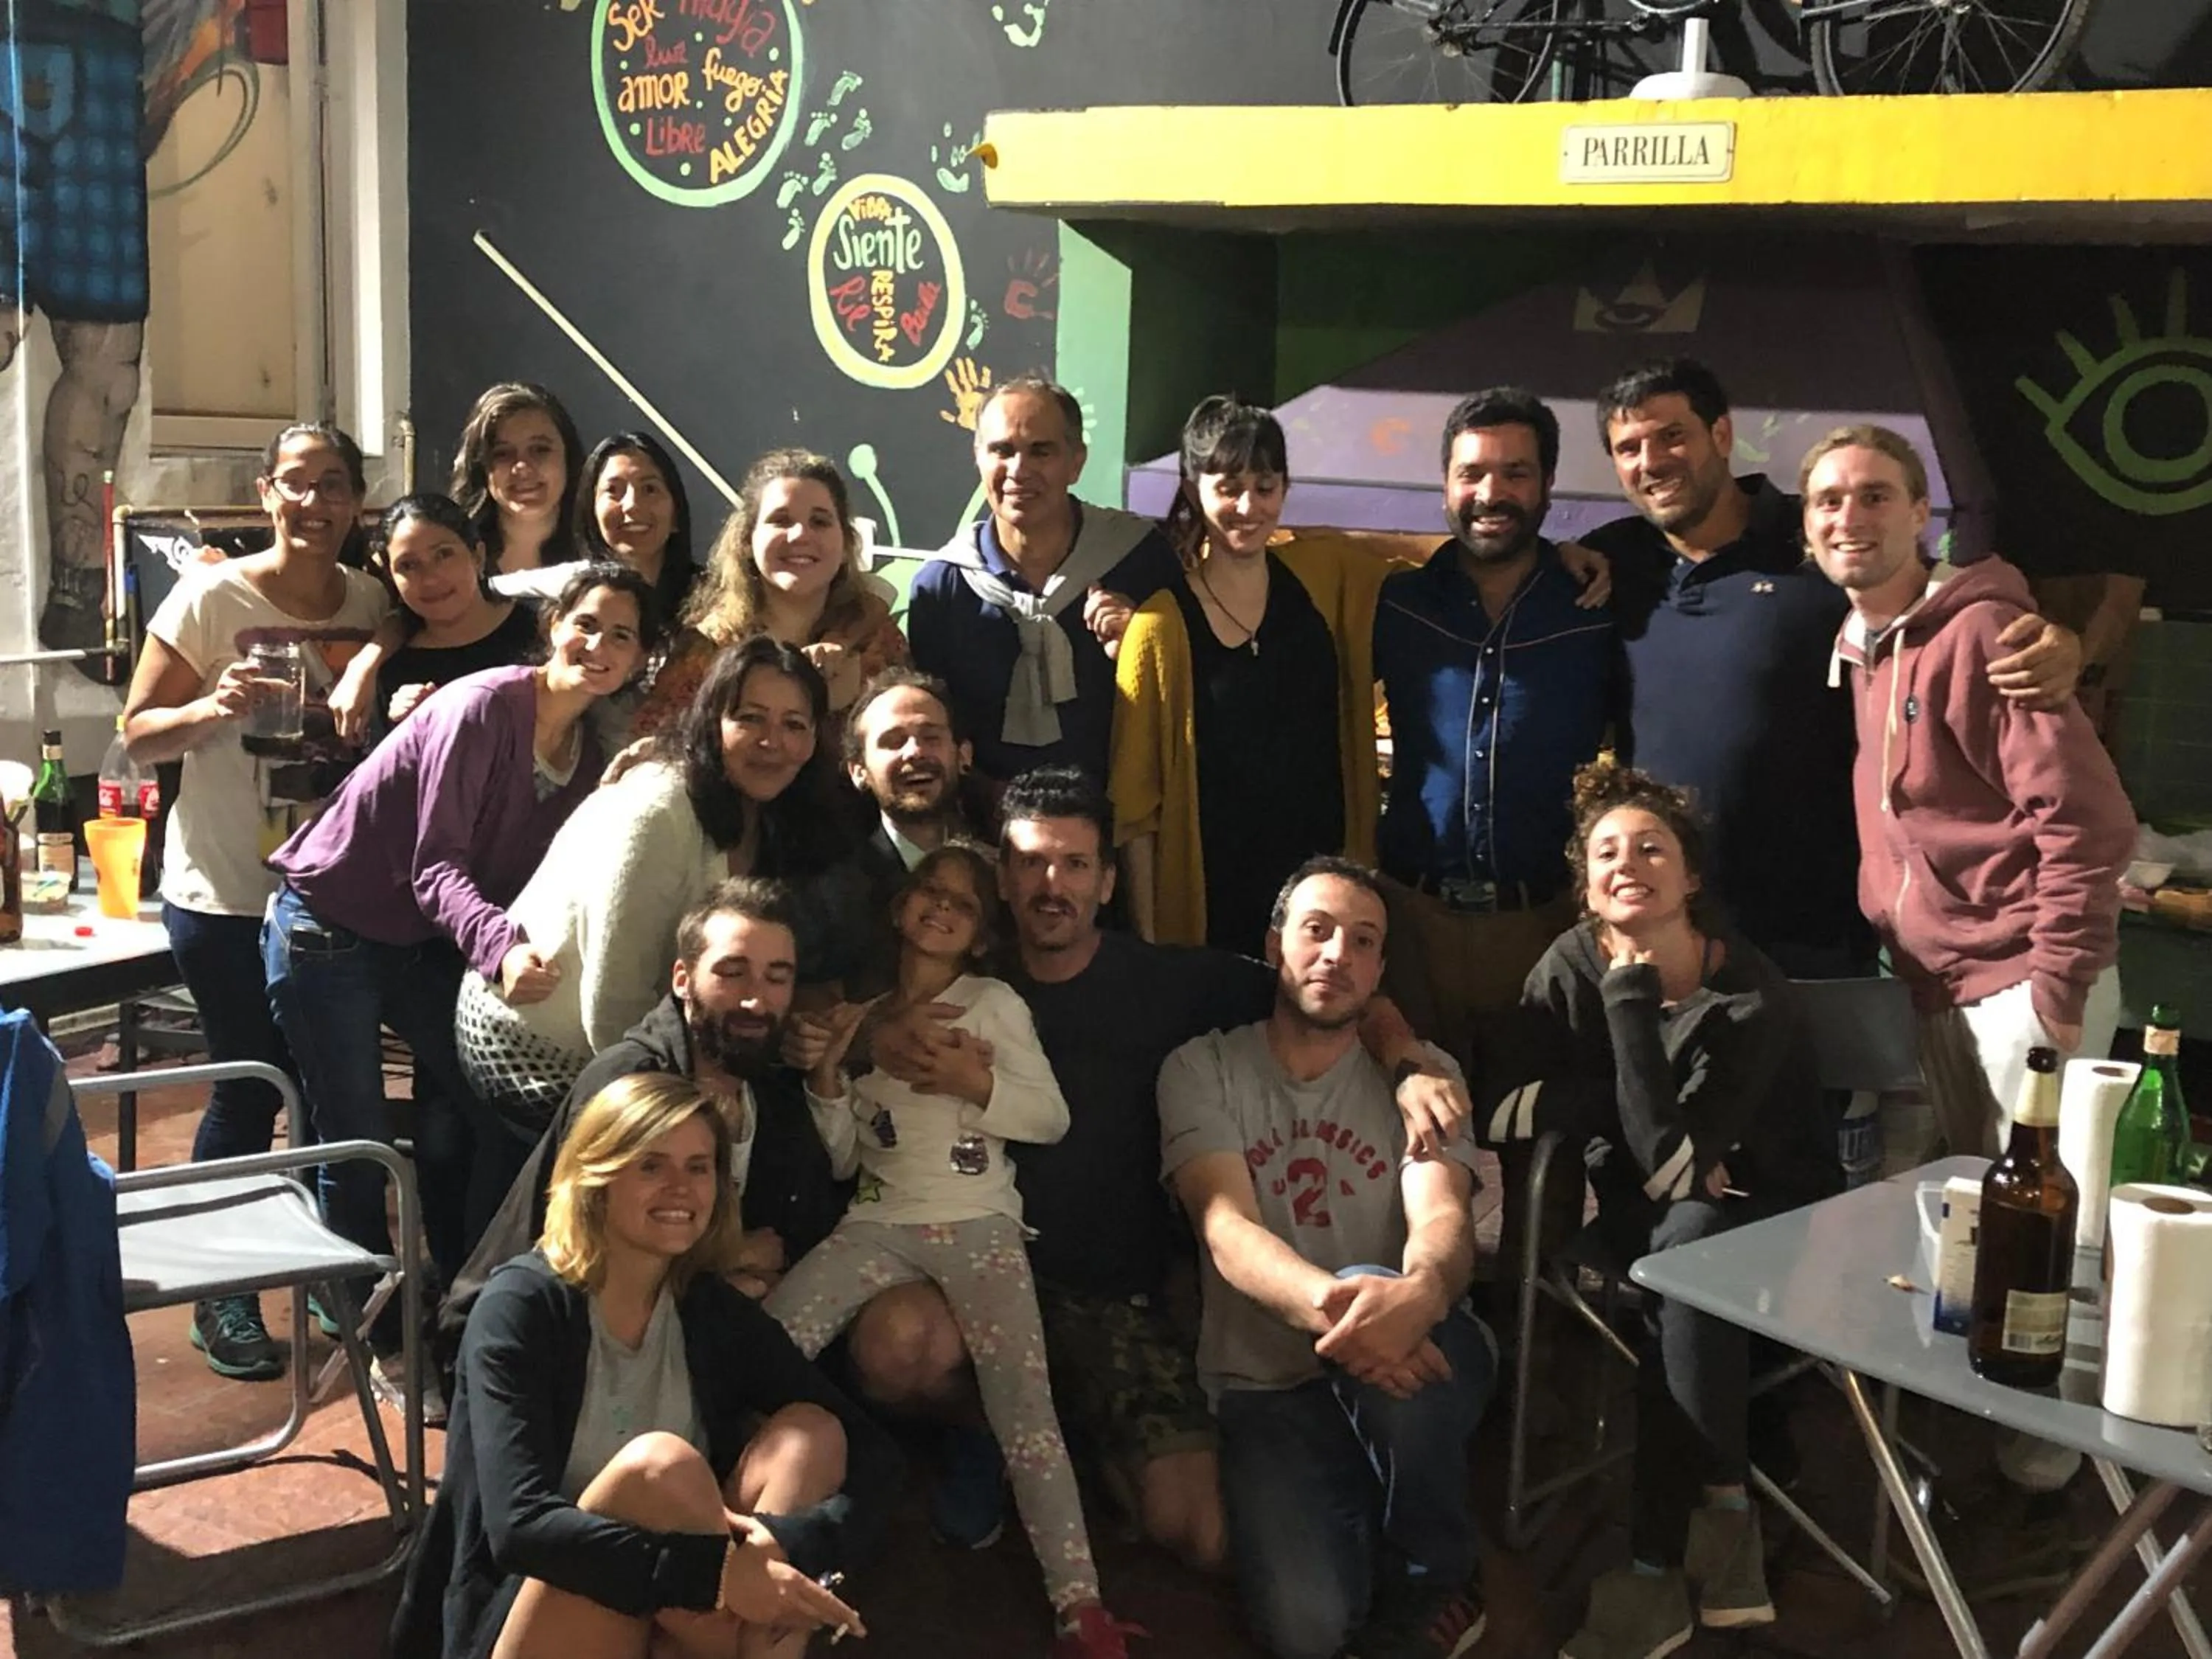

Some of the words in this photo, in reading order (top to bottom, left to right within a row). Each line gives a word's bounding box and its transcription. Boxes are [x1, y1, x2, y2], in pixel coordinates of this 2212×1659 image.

[1582, 135, 1711, 167] PARRILLA
[832, 206, 924, 274] Siente
[1287, 1157, 1332, 1227] 2
